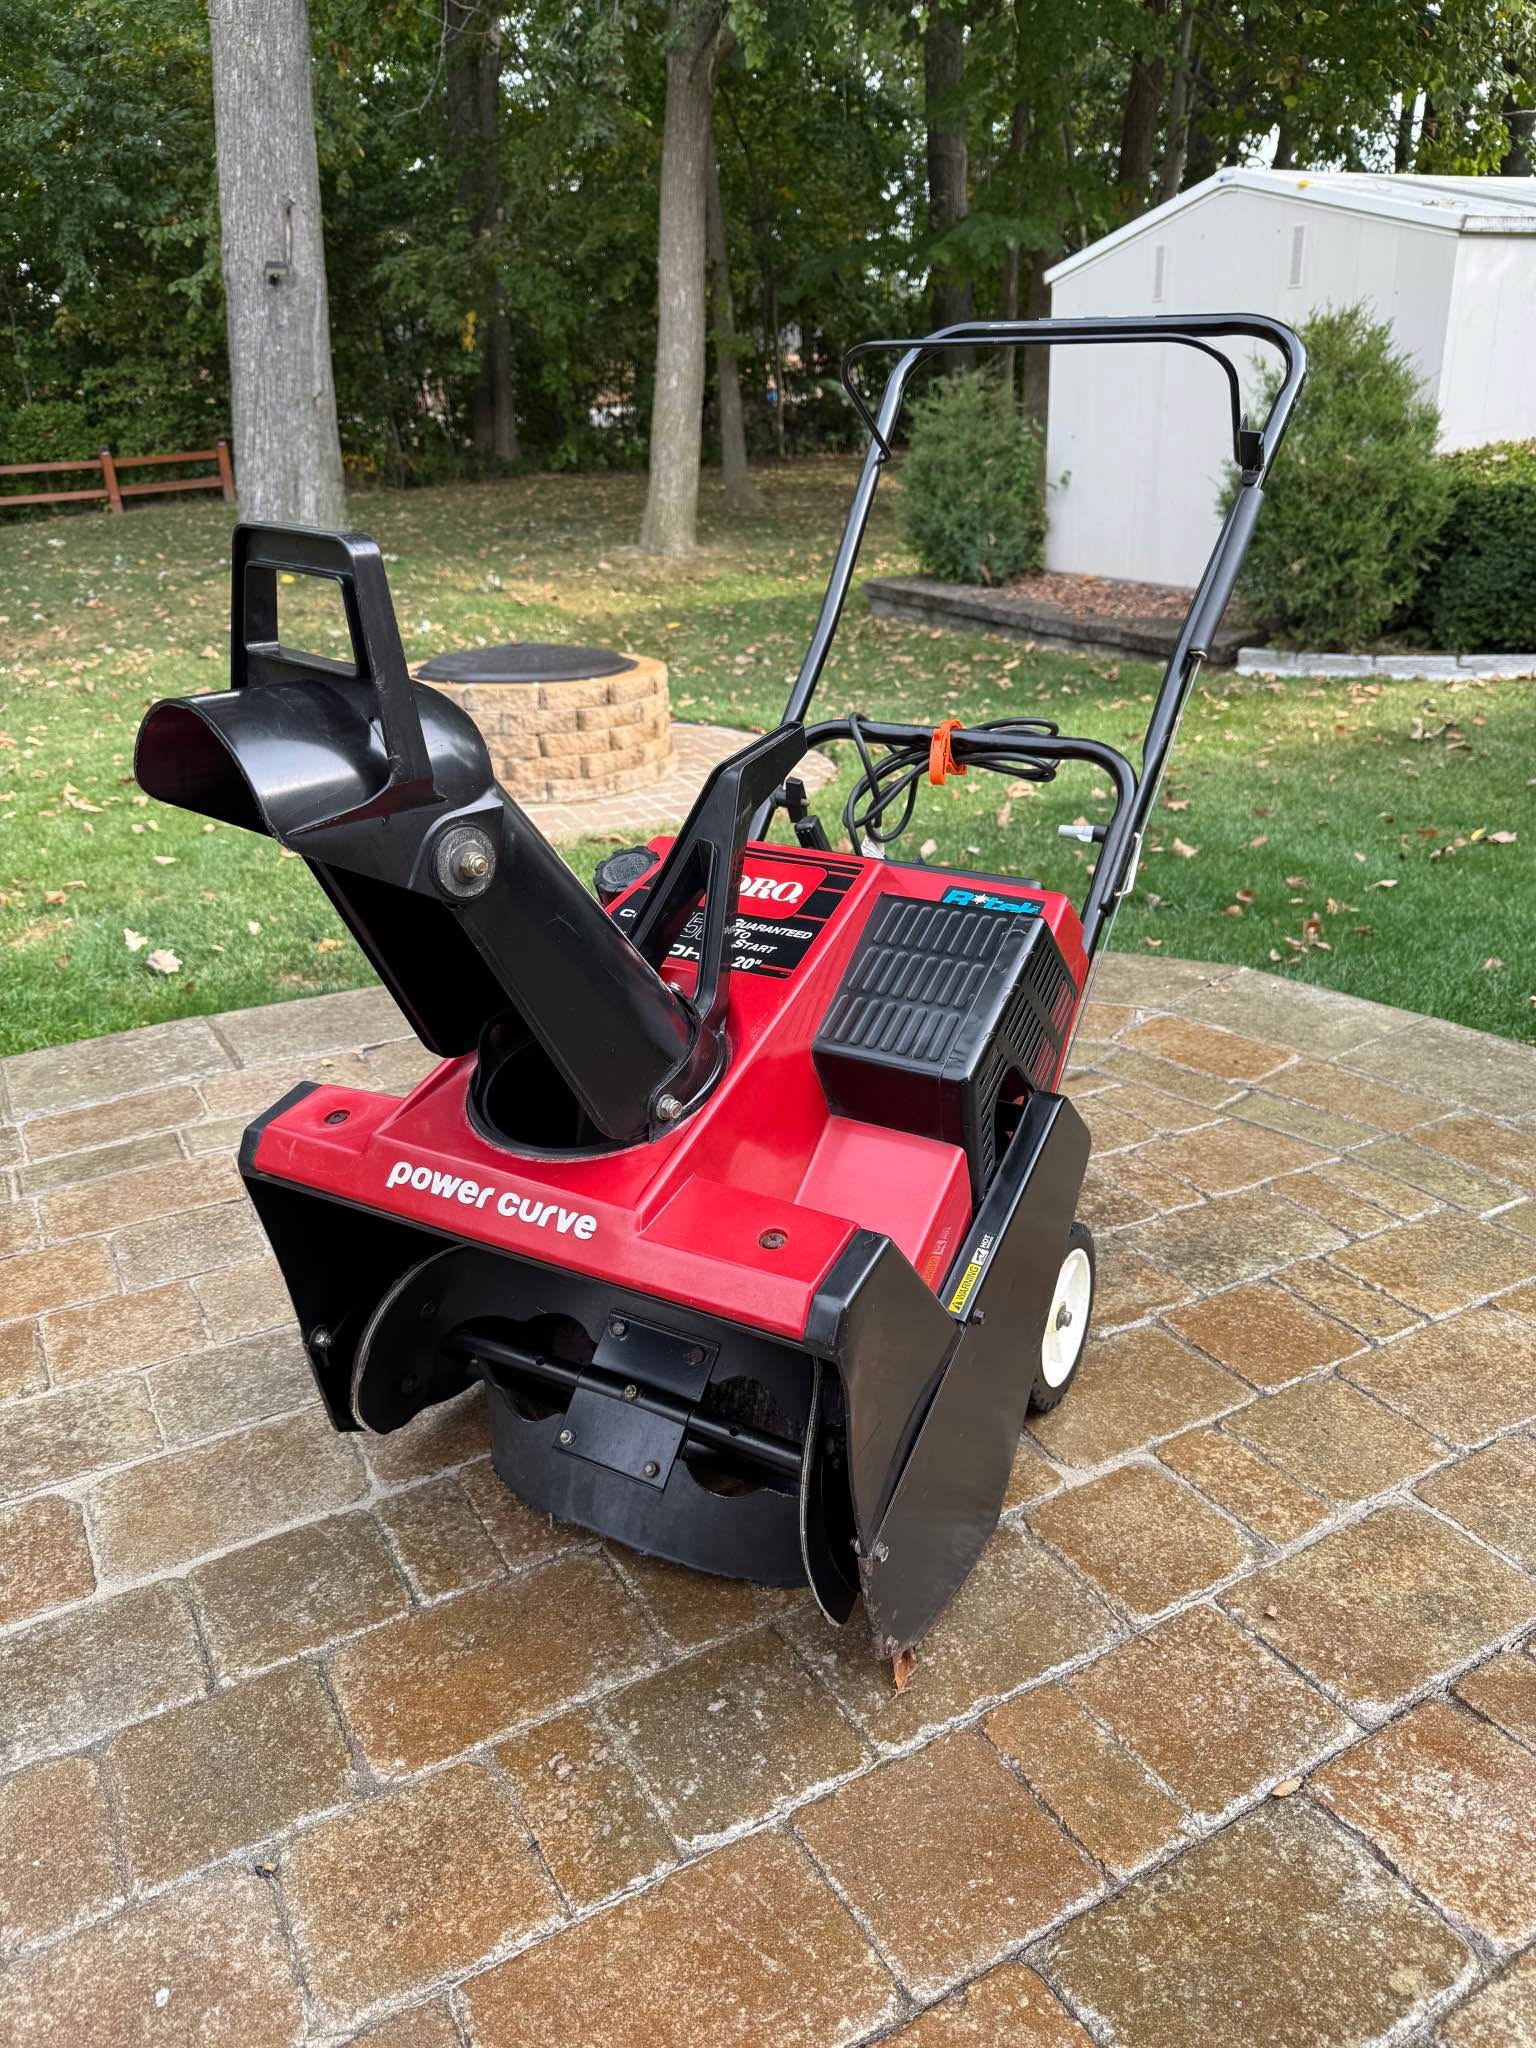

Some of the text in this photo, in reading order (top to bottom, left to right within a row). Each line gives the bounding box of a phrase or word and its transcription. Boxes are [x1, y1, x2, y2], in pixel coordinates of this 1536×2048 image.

[734, 929, 752, 939] TO
[735, 918, 813, 939] GUARANTEED
[733, 939, 778, 954] START
[385, 1161, 598, 1240] power curve
[956, 1265, 979, 1300] WARNING
[980, 1234, 991, 1248] HOT
